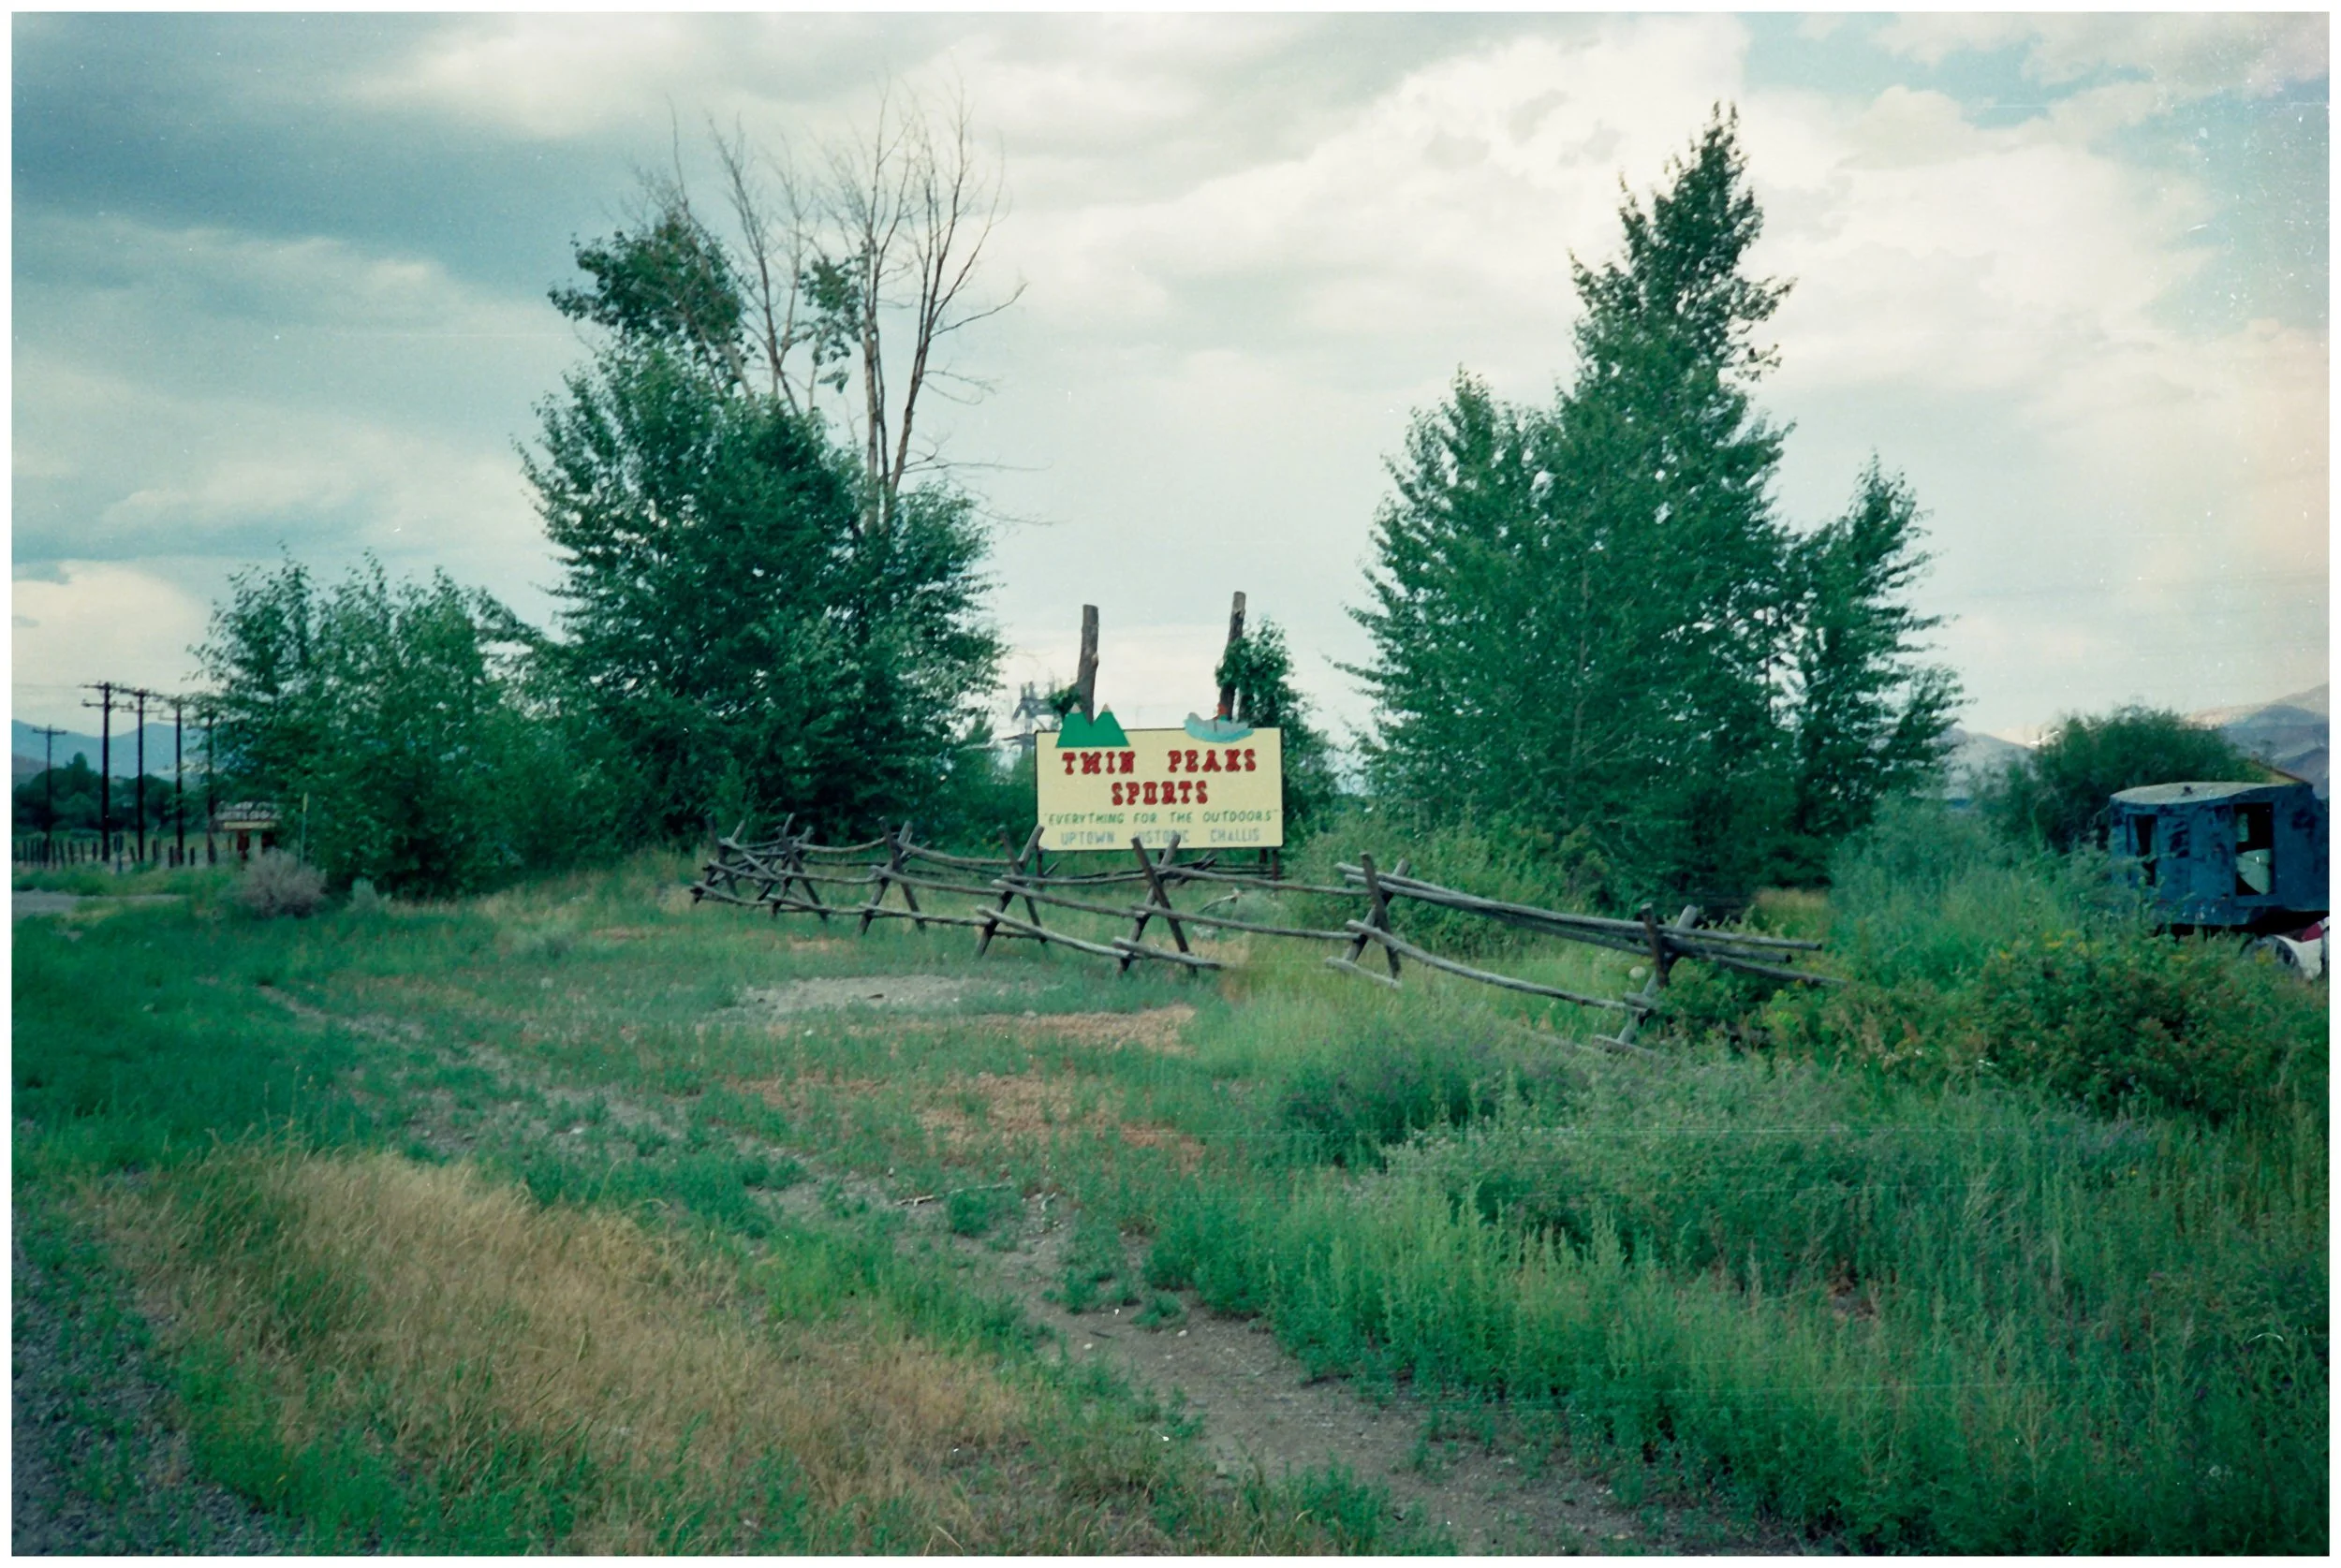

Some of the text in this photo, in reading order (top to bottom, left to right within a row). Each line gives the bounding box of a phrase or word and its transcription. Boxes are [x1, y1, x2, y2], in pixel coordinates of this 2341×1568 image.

[1062, 749, 1257, 775] TWIN PEAKS
[1112, 781, 1208, 805] SPORTS
[1133, 812, 1157, 824] FOR
[1170, 811, 1193, 823] THE
[1060, 830, 1115, 844] UPTOWN
[1210, 828, 1259, 843] CHALLIS
